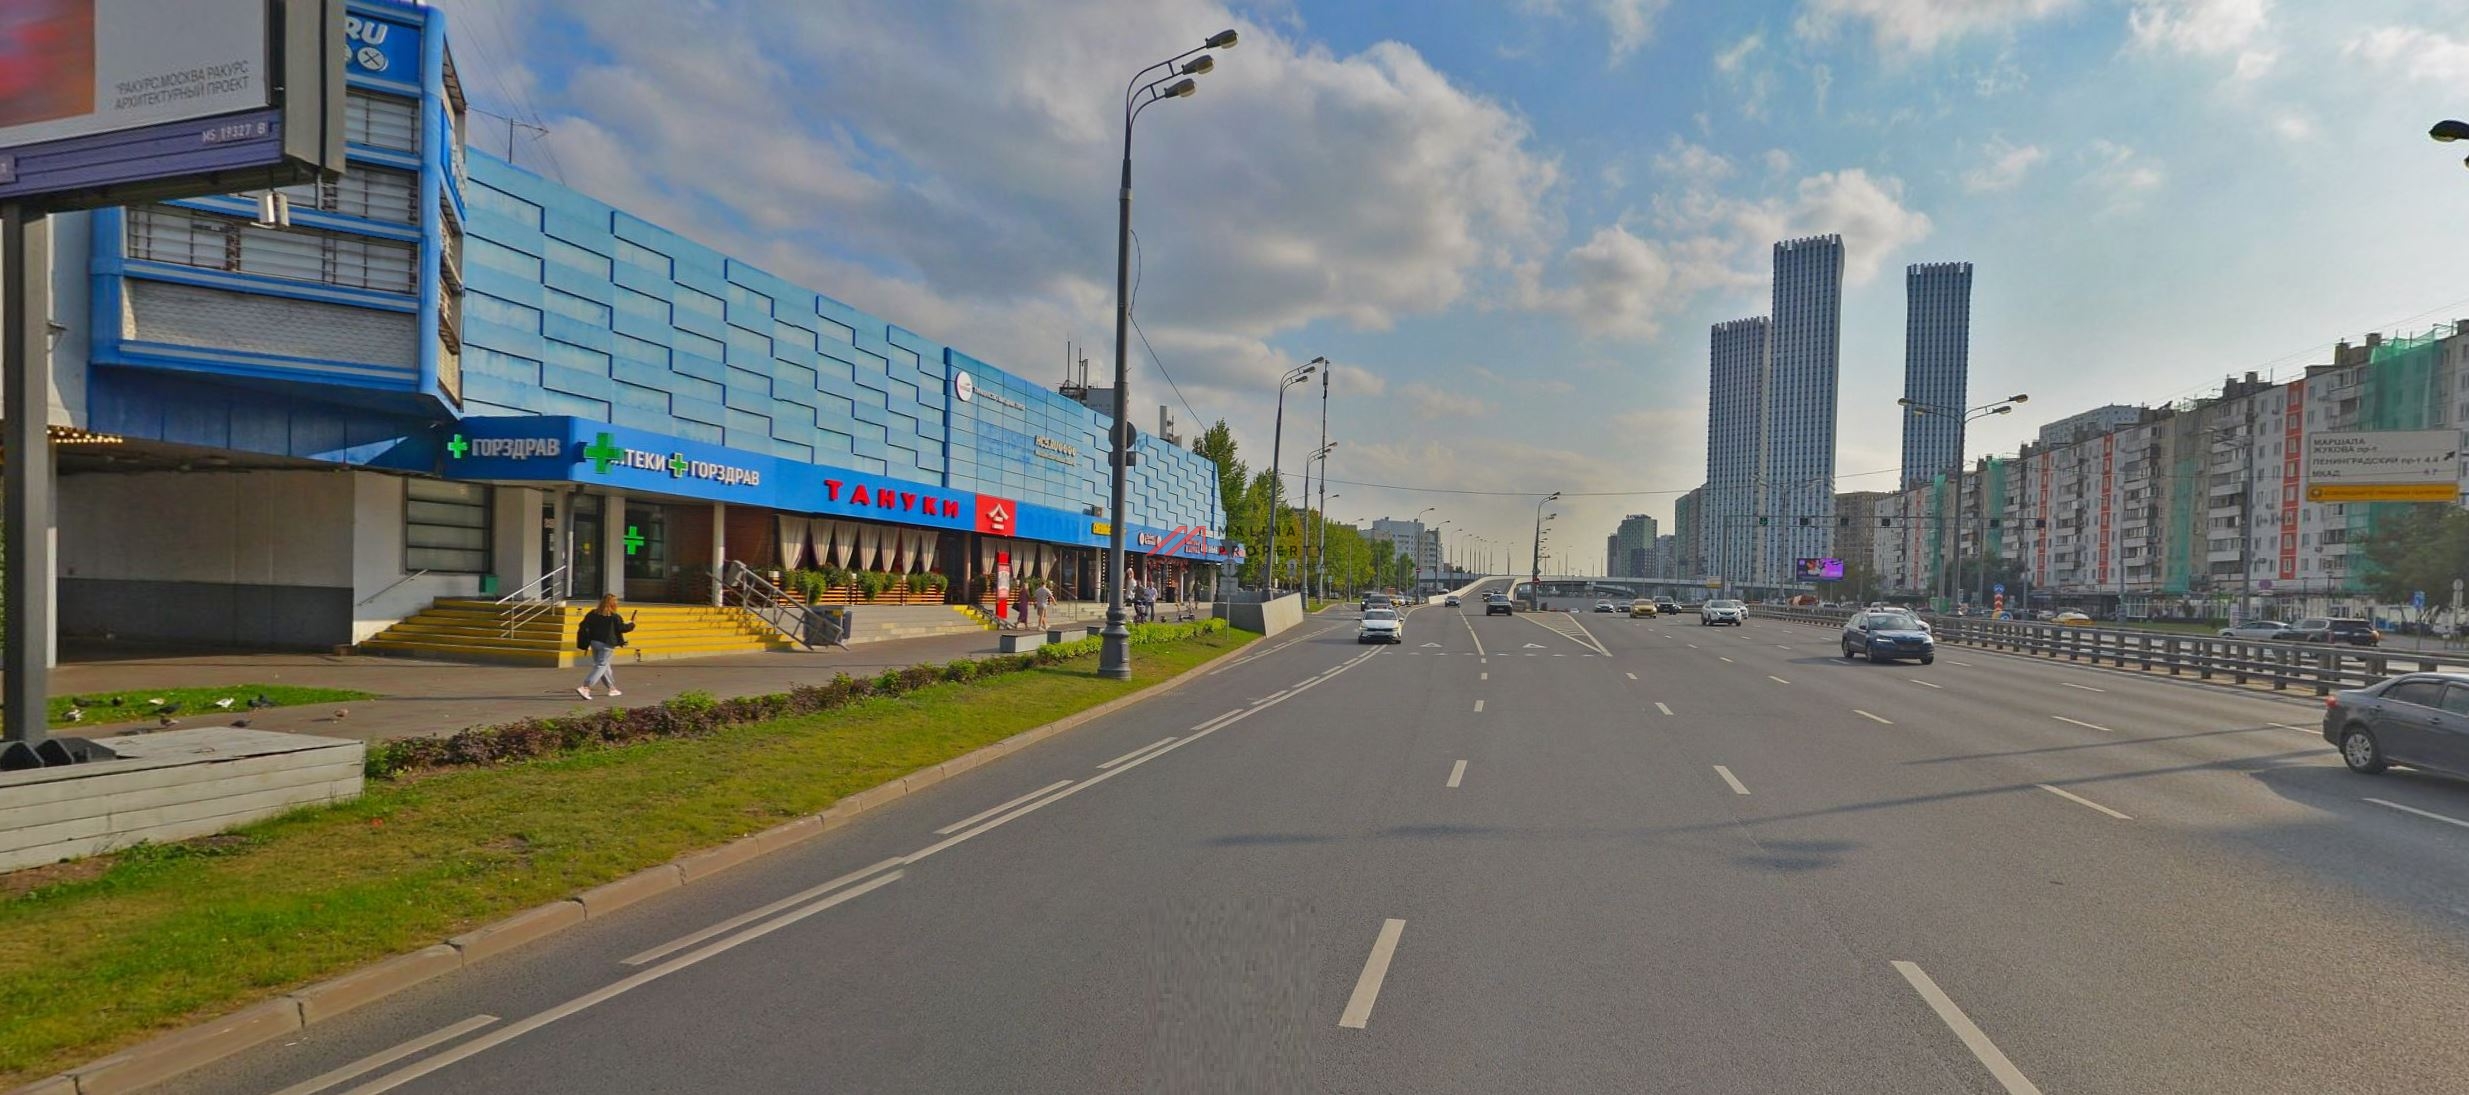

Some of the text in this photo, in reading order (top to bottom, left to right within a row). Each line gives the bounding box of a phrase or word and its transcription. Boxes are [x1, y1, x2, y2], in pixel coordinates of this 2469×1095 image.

[208, 60, 249, 79] РАКУРС
[114, 76, 250, 109] АРХИТЕКТУРНЫЙ ПРОЕКТ
[472, 438, 561, 460] ГОРЗДРАВ
[2313, 446, 2355, 454] ЖУКОВА
[2314, 438, 2366, 446] МАРШАЛА
[610, 448, 761, 487] ТЕКИ ГОРЗДРАВ
[2312, 457, 2398, 465] ЛЕНИНГРАДСКИЙ
[2401, 457, 2421, 465] пр-т
[824, 479, 960, 518] ТАНУКИ
